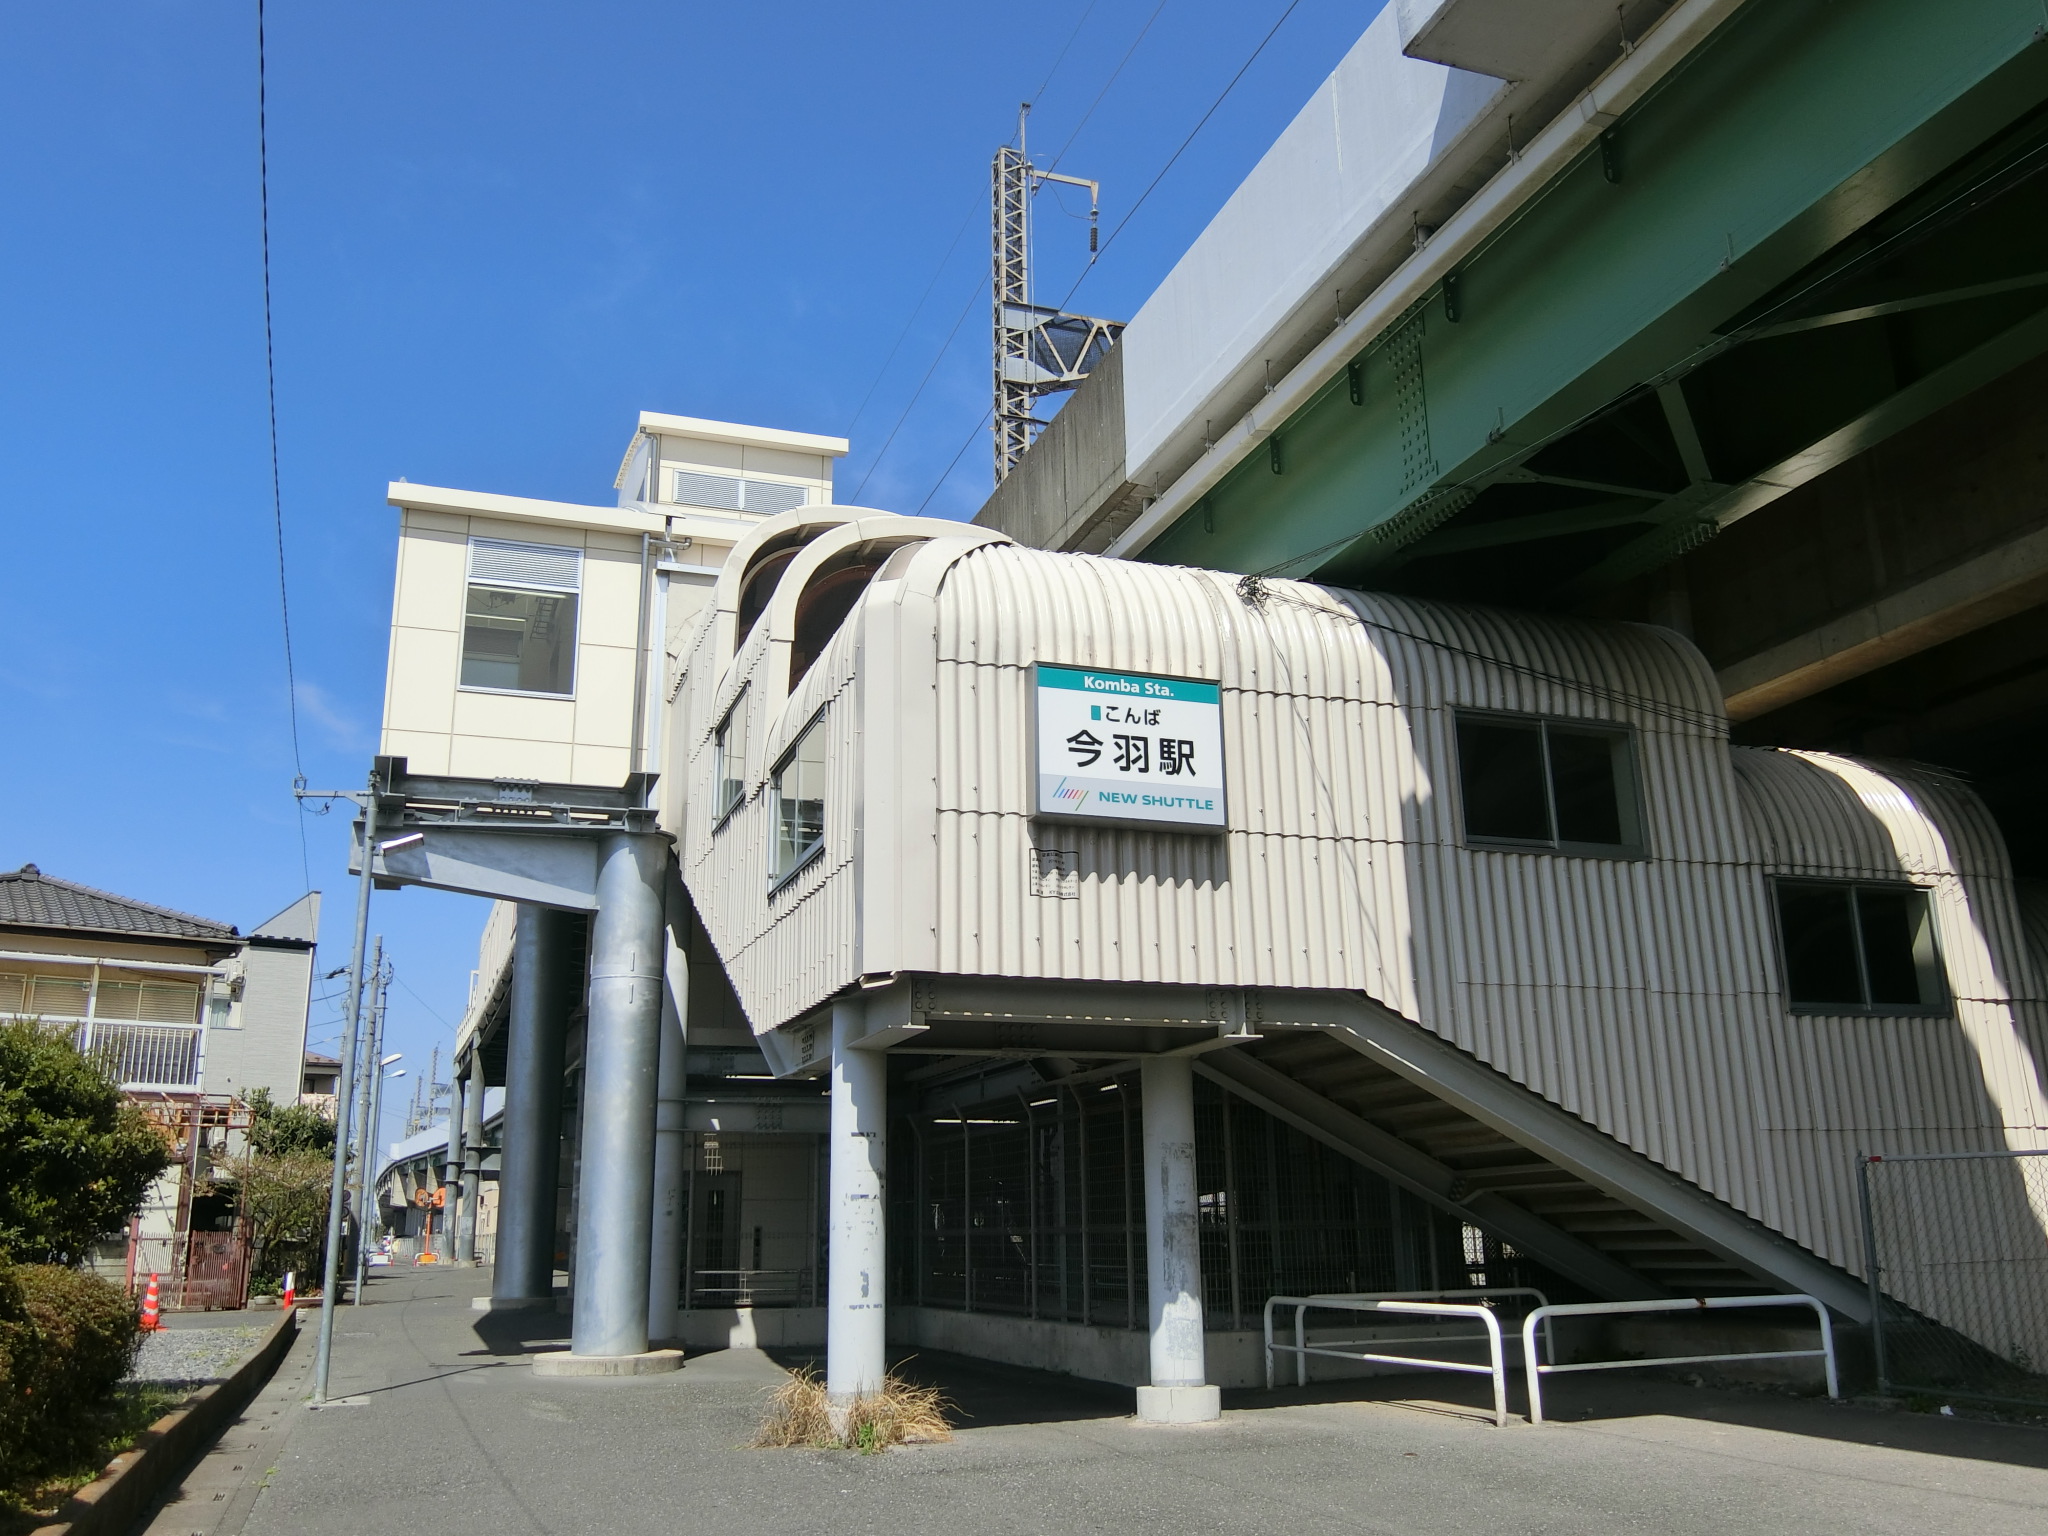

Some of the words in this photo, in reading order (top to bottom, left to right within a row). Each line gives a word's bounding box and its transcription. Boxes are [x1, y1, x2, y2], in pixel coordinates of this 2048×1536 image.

[1084, 676, 1140, 694] Komba
[1145, 682, 1174, 697] Sta.
[1106, 705, 1161, 726] こんば
[1066, 729, 1196, 777] 今羽駅
[1099, 791, 1137, 804] NEW
[1142, 794, 1214, 810] SHUTTLE
